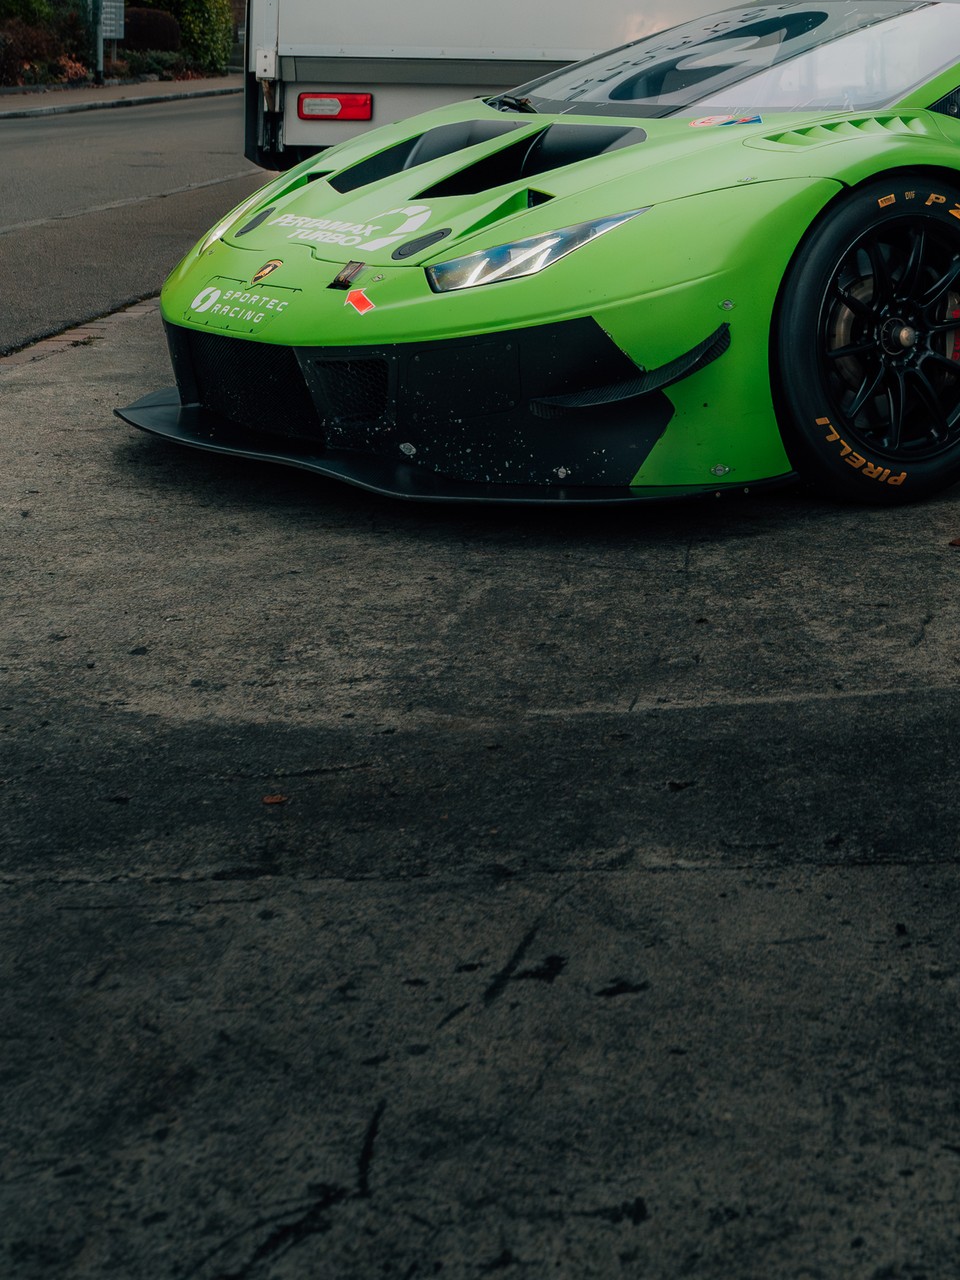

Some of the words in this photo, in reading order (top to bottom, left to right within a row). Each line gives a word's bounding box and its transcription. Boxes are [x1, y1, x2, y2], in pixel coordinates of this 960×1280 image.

[267, 213, 382, 237] PERTAMAX
[286, 229, 362, 246] TURBO
[222, 289, 289, 312] SPORTEC
[210, 303, 265, 323] RACING
[815, 415, 909, 486] PIRELLI
